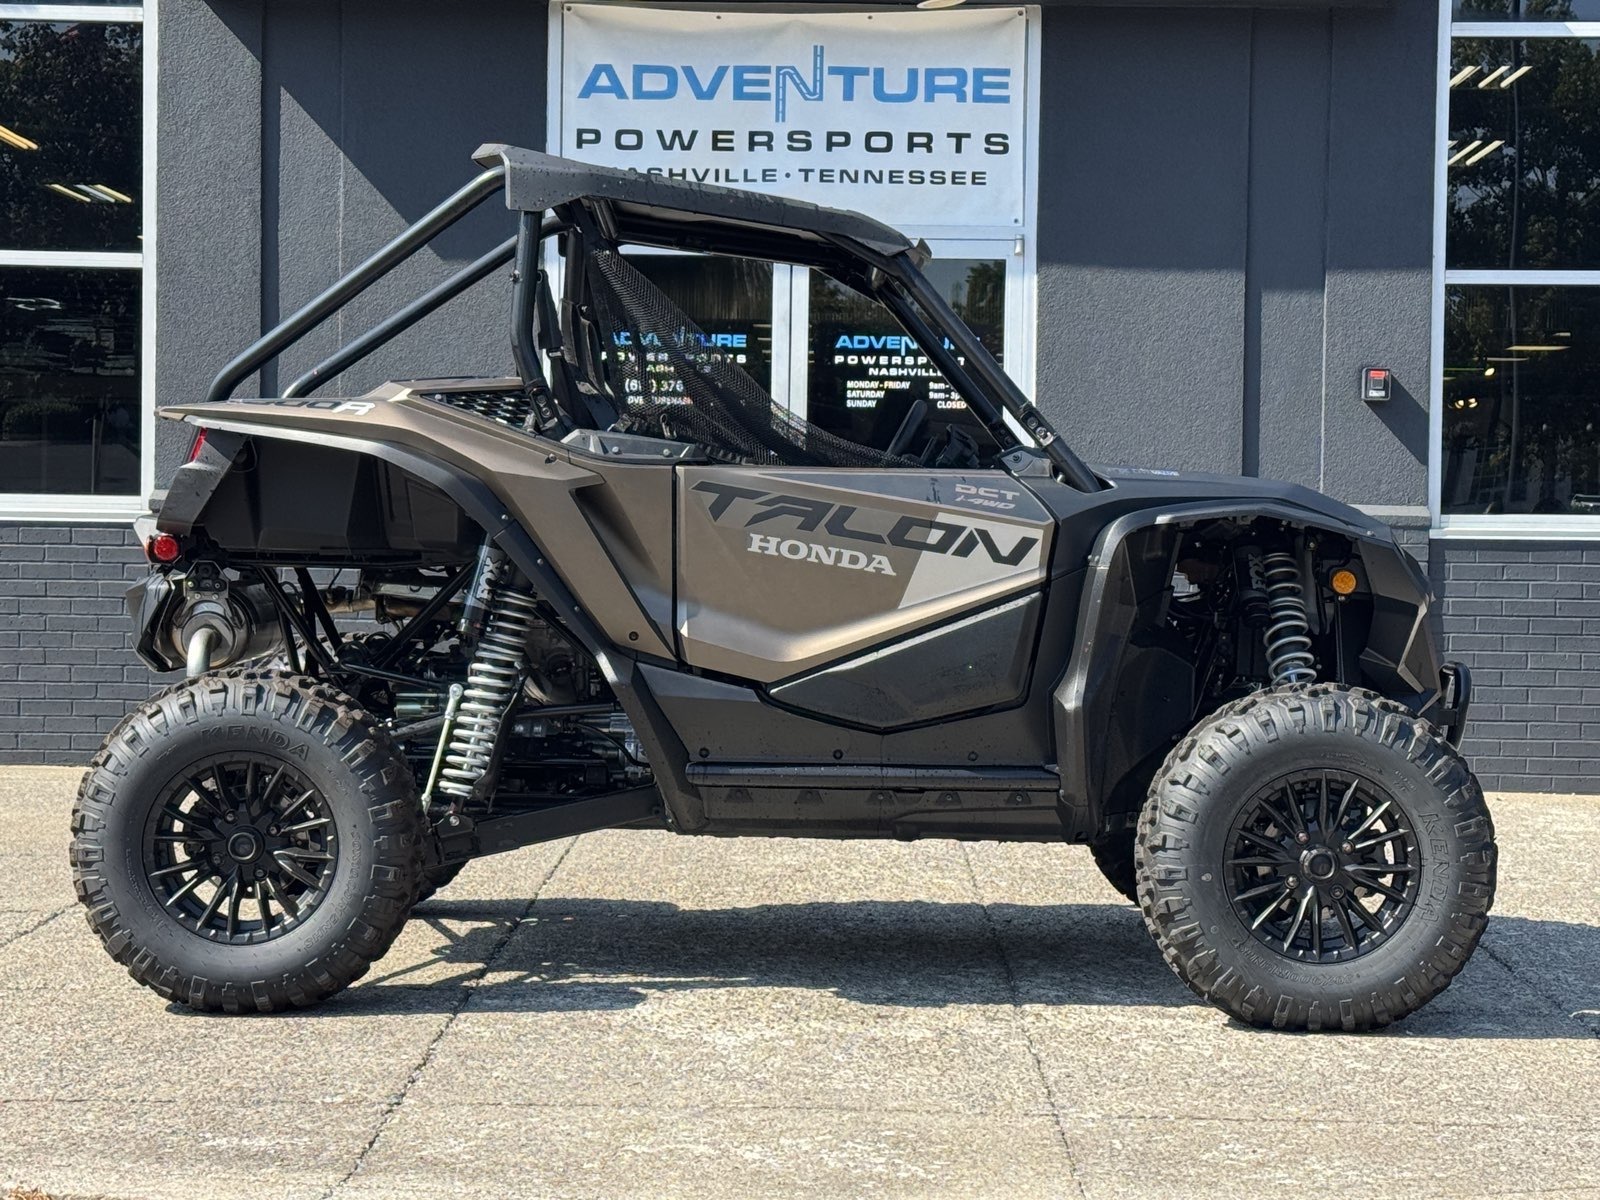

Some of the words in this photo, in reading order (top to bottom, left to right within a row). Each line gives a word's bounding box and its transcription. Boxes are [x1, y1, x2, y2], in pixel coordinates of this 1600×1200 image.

[577, 45, 1011, 123] ADVENTURE
[576, 128, 1010, 155] POWERSPORTS
[628, 167, 778, 183] SHVILLE
[798, 168, 988, 186] TENNESSEE
[835, 335, 956, 355] ADVEN
[834, 355, 966, 366] POWERSPT
[846, 389, 886, 399] SATURDAY
[846, 399, 878, 408] SUNDAY
[936, 401, 968, 409] CLOSED
[954, 483, 1021, 501] DCT
[691, 480, 1040, 567] TALON
[747, 532, 897, 577] HONDA
[200, 724, 310, 762] KENDA
[1418, 812, 1451, 923] KENDA
